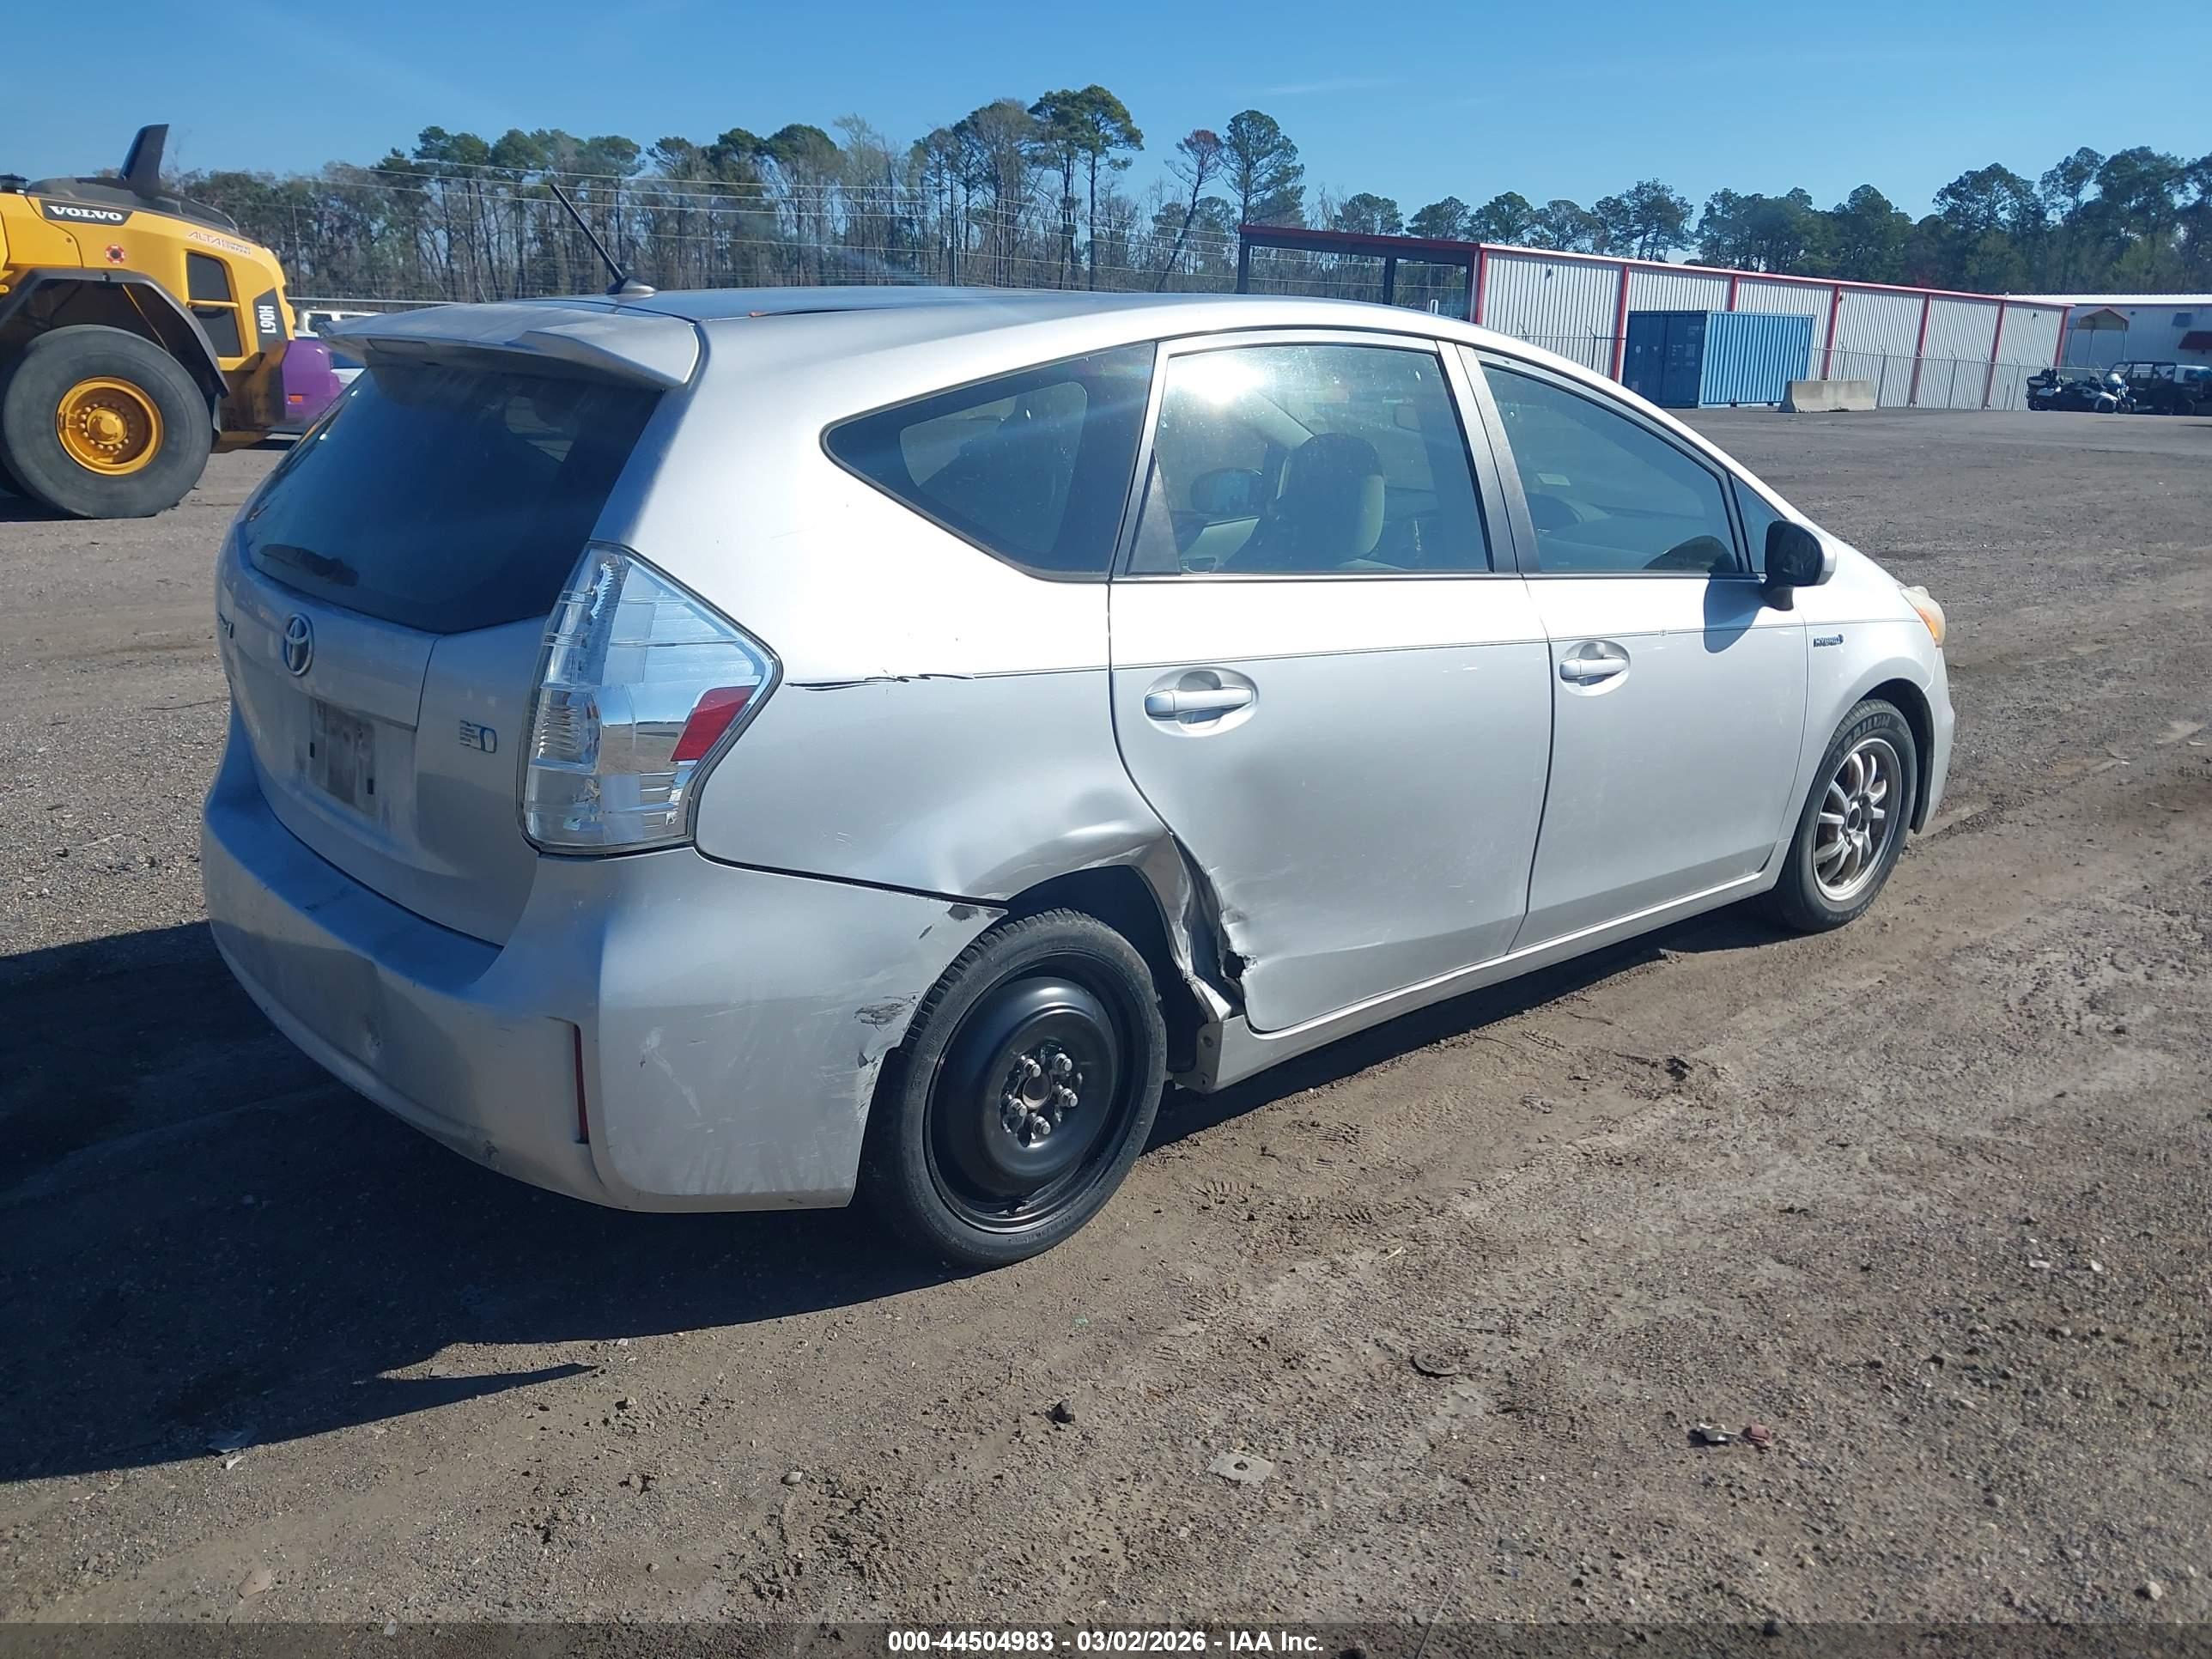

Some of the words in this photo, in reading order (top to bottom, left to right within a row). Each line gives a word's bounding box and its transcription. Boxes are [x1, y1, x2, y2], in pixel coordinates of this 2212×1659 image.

[48, 205, 123, 221] VOLVO
[188, 231, 222, 246] ALTA
[258, 305, 276, 333] L90H
